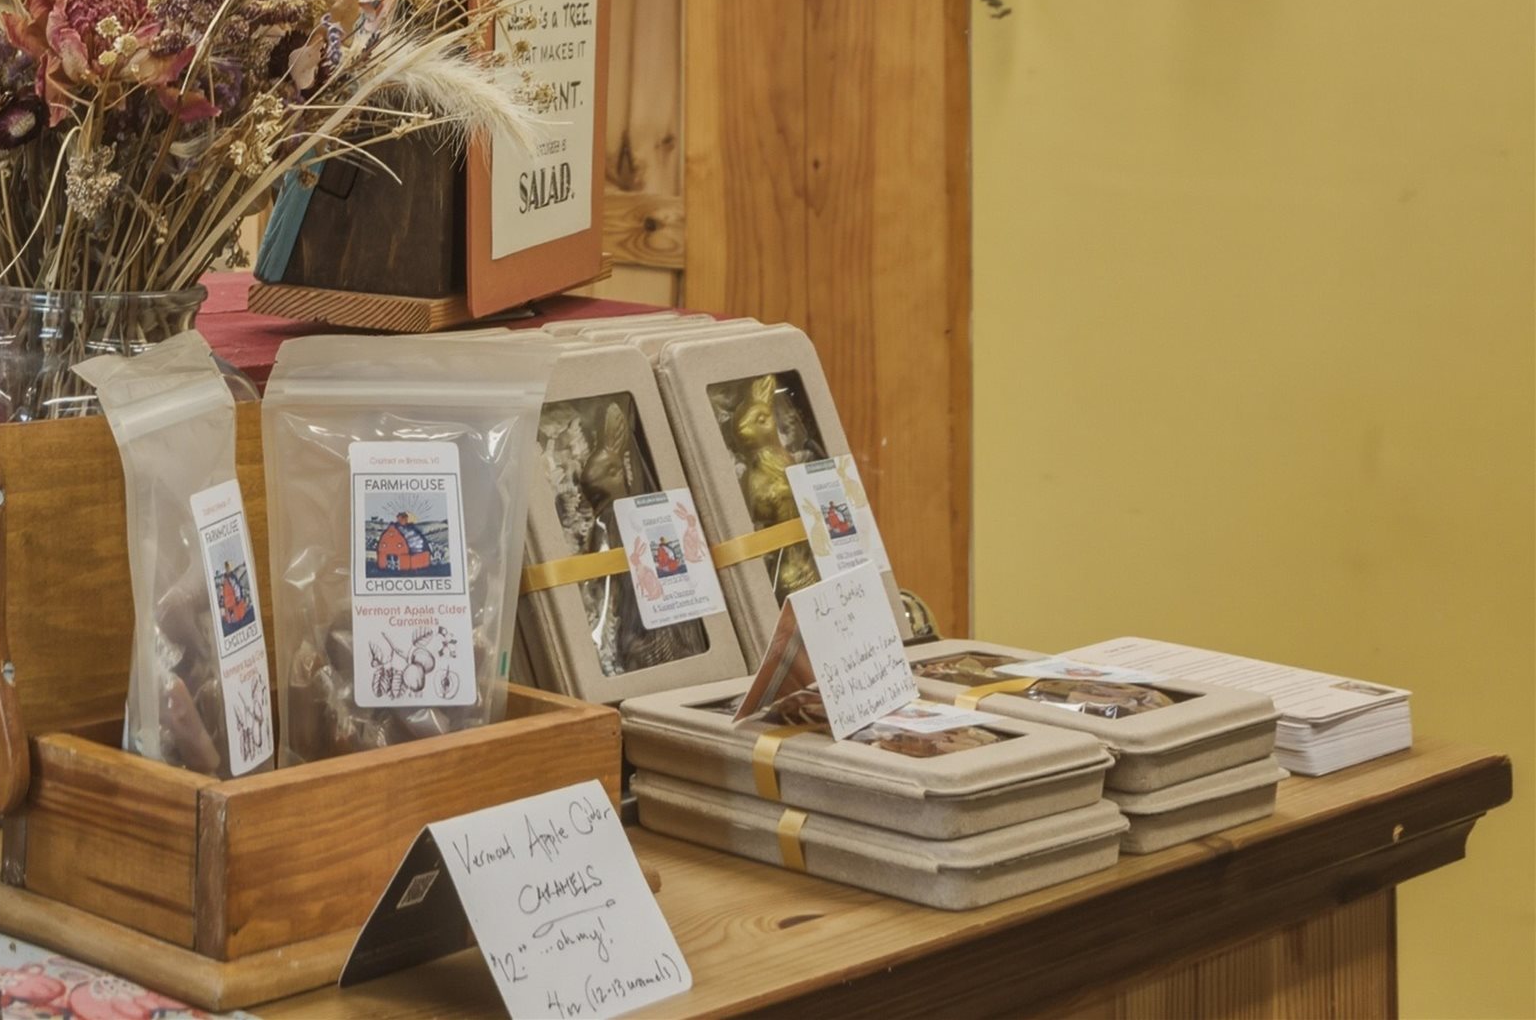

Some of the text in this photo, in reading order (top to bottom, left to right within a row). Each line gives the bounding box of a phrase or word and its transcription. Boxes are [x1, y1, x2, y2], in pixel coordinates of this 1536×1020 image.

[540, 42, 574, 63] MAKES
[519, 162, 575, 214] SALAD.
[365, 478, 446, 491] FARMHOUSE
[365, 579, 452, 592] CHOCOLATES
[355, 604, 467, 617] Vermont Apple Cider
[389, 616, 439, 627] Caramels
[453, 796, 612, 875] Vermont Apple Cider
[518, 865, 603, 915] CARAMELS
[576, 916, 614, 963] my!
